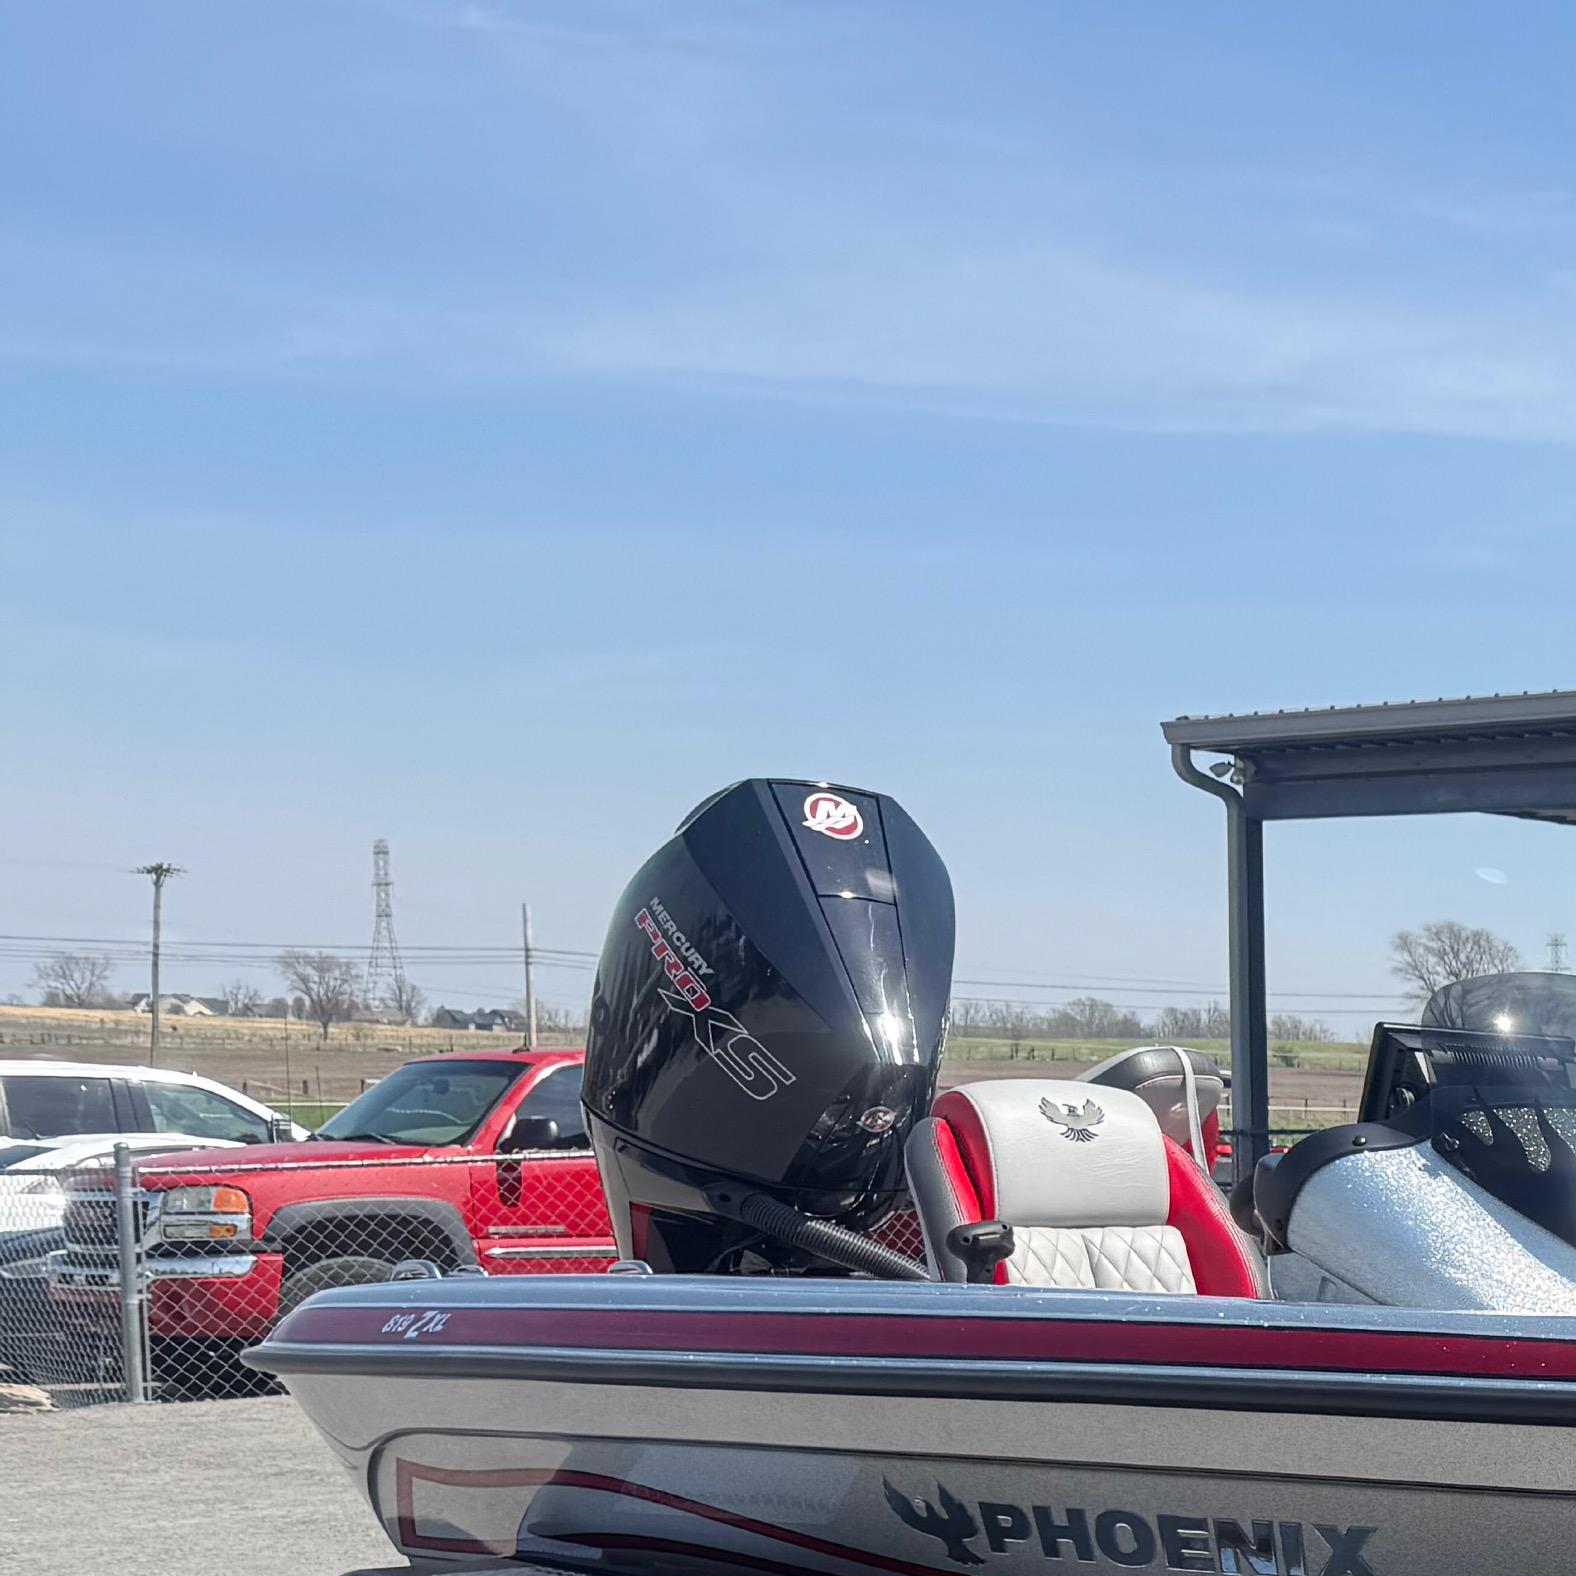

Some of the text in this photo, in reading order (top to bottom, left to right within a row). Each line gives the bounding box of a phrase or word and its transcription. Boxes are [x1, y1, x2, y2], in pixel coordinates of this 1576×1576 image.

[634, 908, 796, 1100] PRO XS
[650, 897, 715, 977] MERCURY
